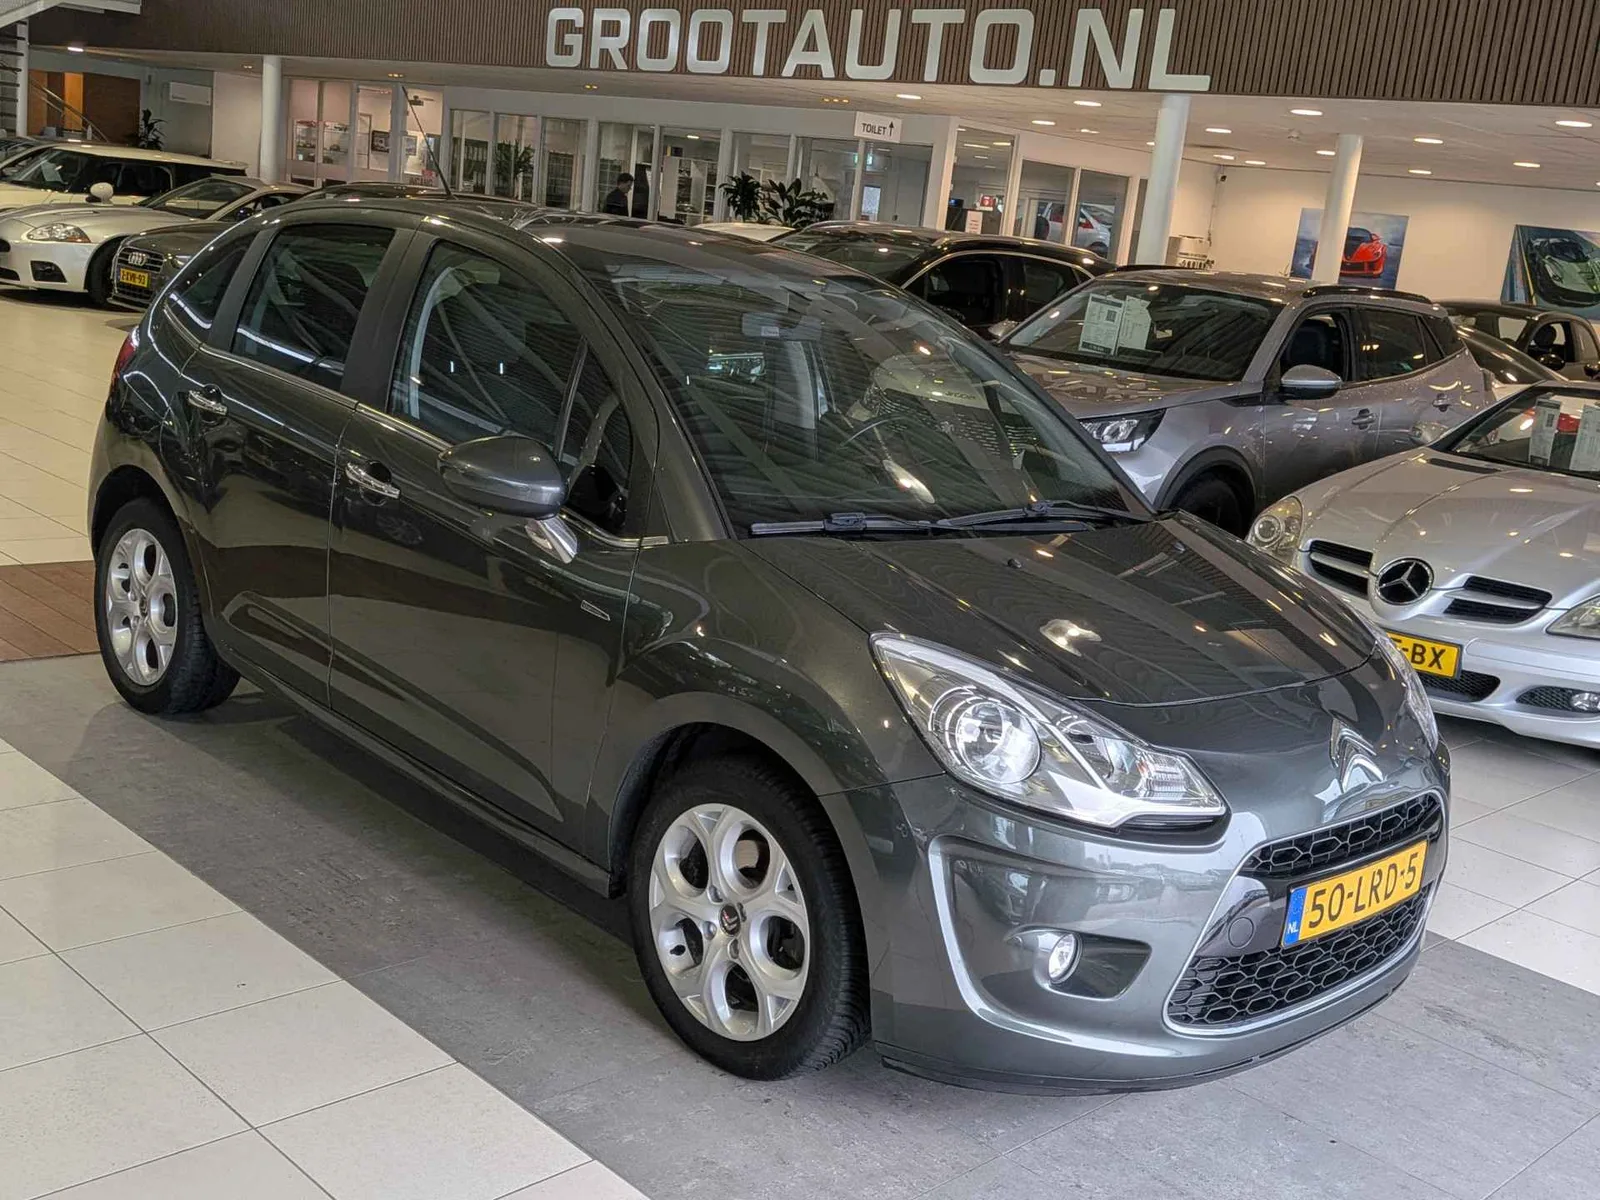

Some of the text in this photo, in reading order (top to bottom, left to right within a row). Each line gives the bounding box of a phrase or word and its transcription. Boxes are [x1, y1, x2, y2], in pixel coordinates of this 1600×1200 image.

[546, 8, 1211, 91] GROOTAUTO.NL
[861, 122, 887, 135] TOILET
[1391, 637, 1446, 671] -BX
[1308, 852, 1418, 929] 50-LRD-5
[1287, 921, 1299, 934] NL
